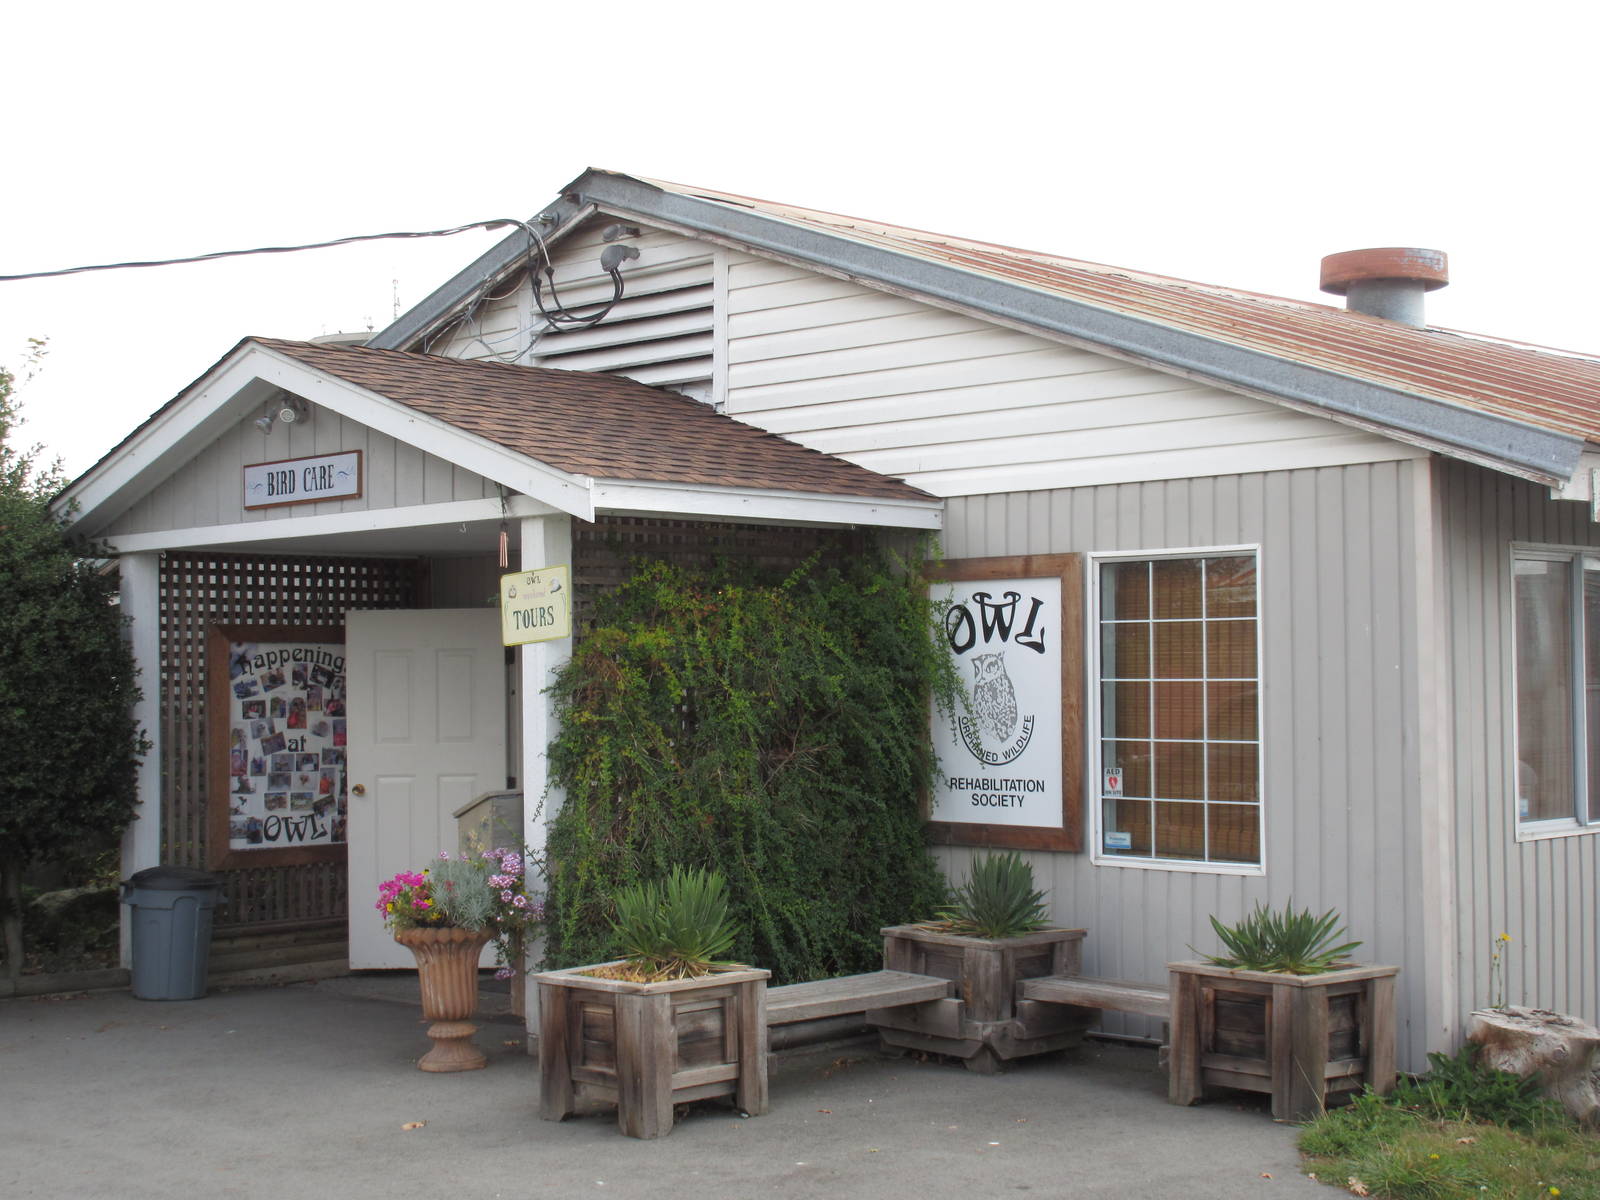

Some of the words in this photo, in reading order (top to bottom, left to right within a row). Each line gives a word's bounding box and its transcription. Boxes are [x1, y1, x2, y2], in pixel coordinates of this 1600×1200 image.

[267, 470, 296, 496] BIRD
[303, 464, 335, 492] CARE
[513, 605, 555, 630] TOURS
[946, 591, 1045, 655] OWL
[240, 646, 346, 676] happening
[287, 735, 307, 752] at
[1002, 714, 1032, 760] WILDLIFE
[950, 777, 1045, 793] REHABILITATION
[971, 793, 1025, 807] SOCIETY
[263, 814, 329, 842] OWL
